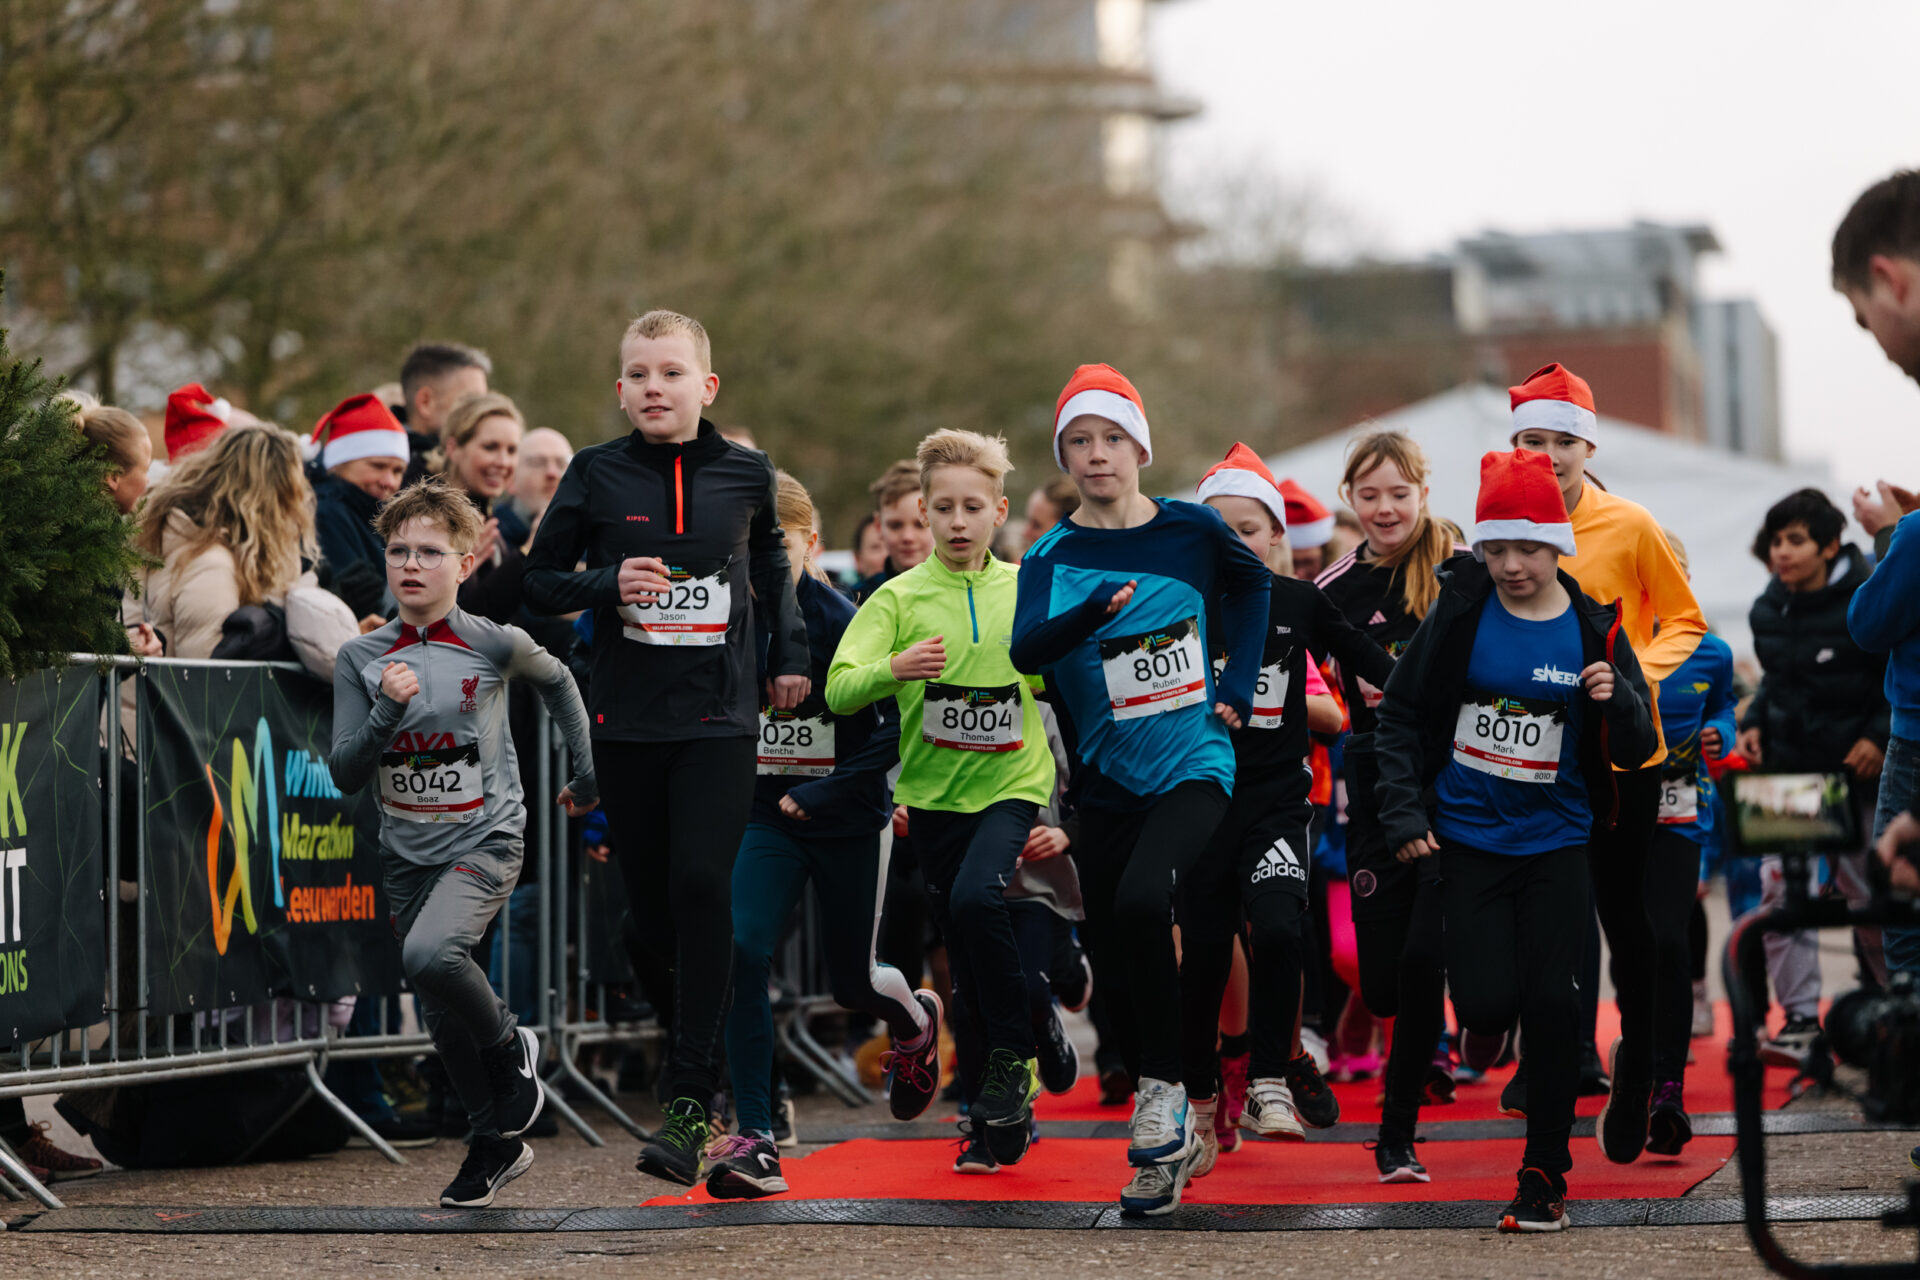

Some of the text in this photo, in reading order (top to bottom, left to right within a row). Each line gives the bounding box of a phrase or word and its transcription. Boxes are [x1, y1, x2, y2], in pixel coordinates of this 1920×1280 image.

[659, 613, 686, 621] Jason
[1133, 647, 1190, 682] 8011
[1532, 663, 1583, 688] SNEEK
[1152, 677, 1181, 690] Ruben
[942, 707, 1012, 732] 8004
[1475, 713, 1541, 747] 8010
[758, 723, 813, 747] 028
[961, 732, 995, 742] Thomas
[763, 747, 794, 755] Benthe
[1493, 743, 1516, 755] Mark
[391, 770, 462, 794] 8042
[417, 795, 440, 803] Boaz
[1251, 861, 1306, 884] adidas
